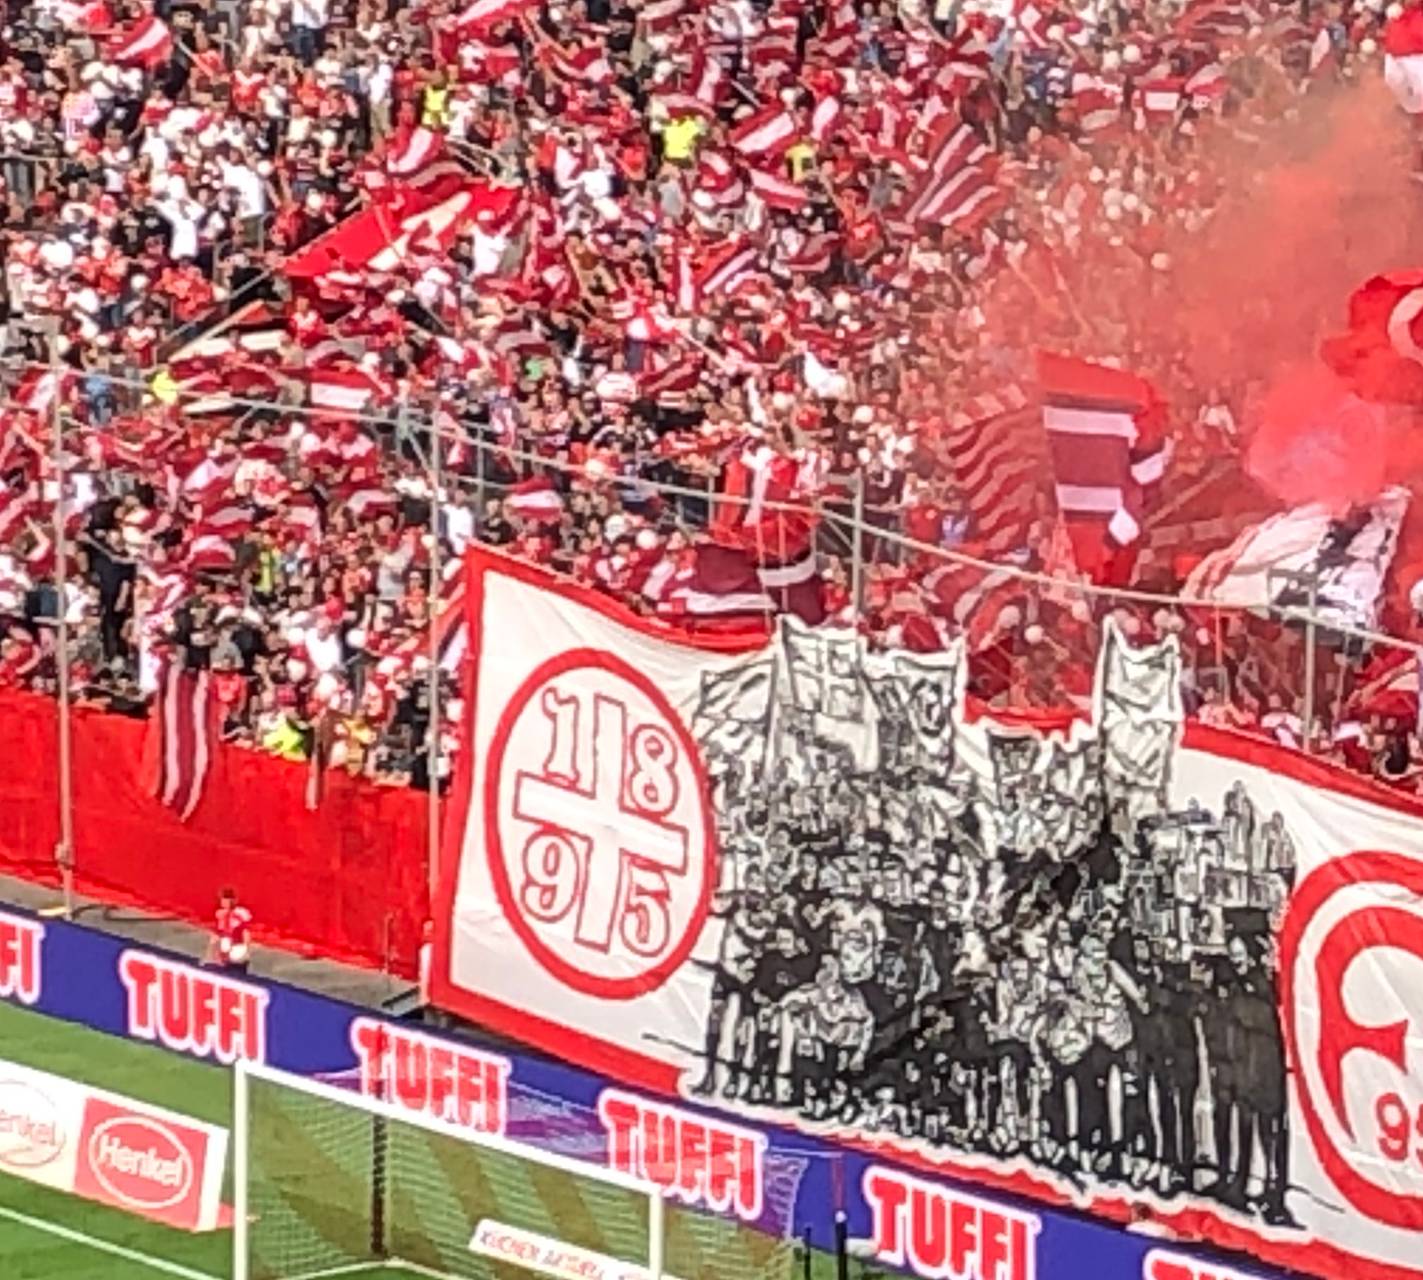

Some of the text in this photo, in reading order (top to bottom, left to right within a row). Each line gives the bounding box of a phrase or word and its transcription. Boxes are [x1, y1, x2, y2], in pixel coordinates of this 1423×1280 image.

[121, 952, 266, 1063] TUFFI
[352, 1018, 508, 1136] TUFFI
[99, 1133, 183, 1186] Henkel
[600, 1092, 765, 1218] TUFFI
[865, 1168, 1038, 1280] TUFFI
